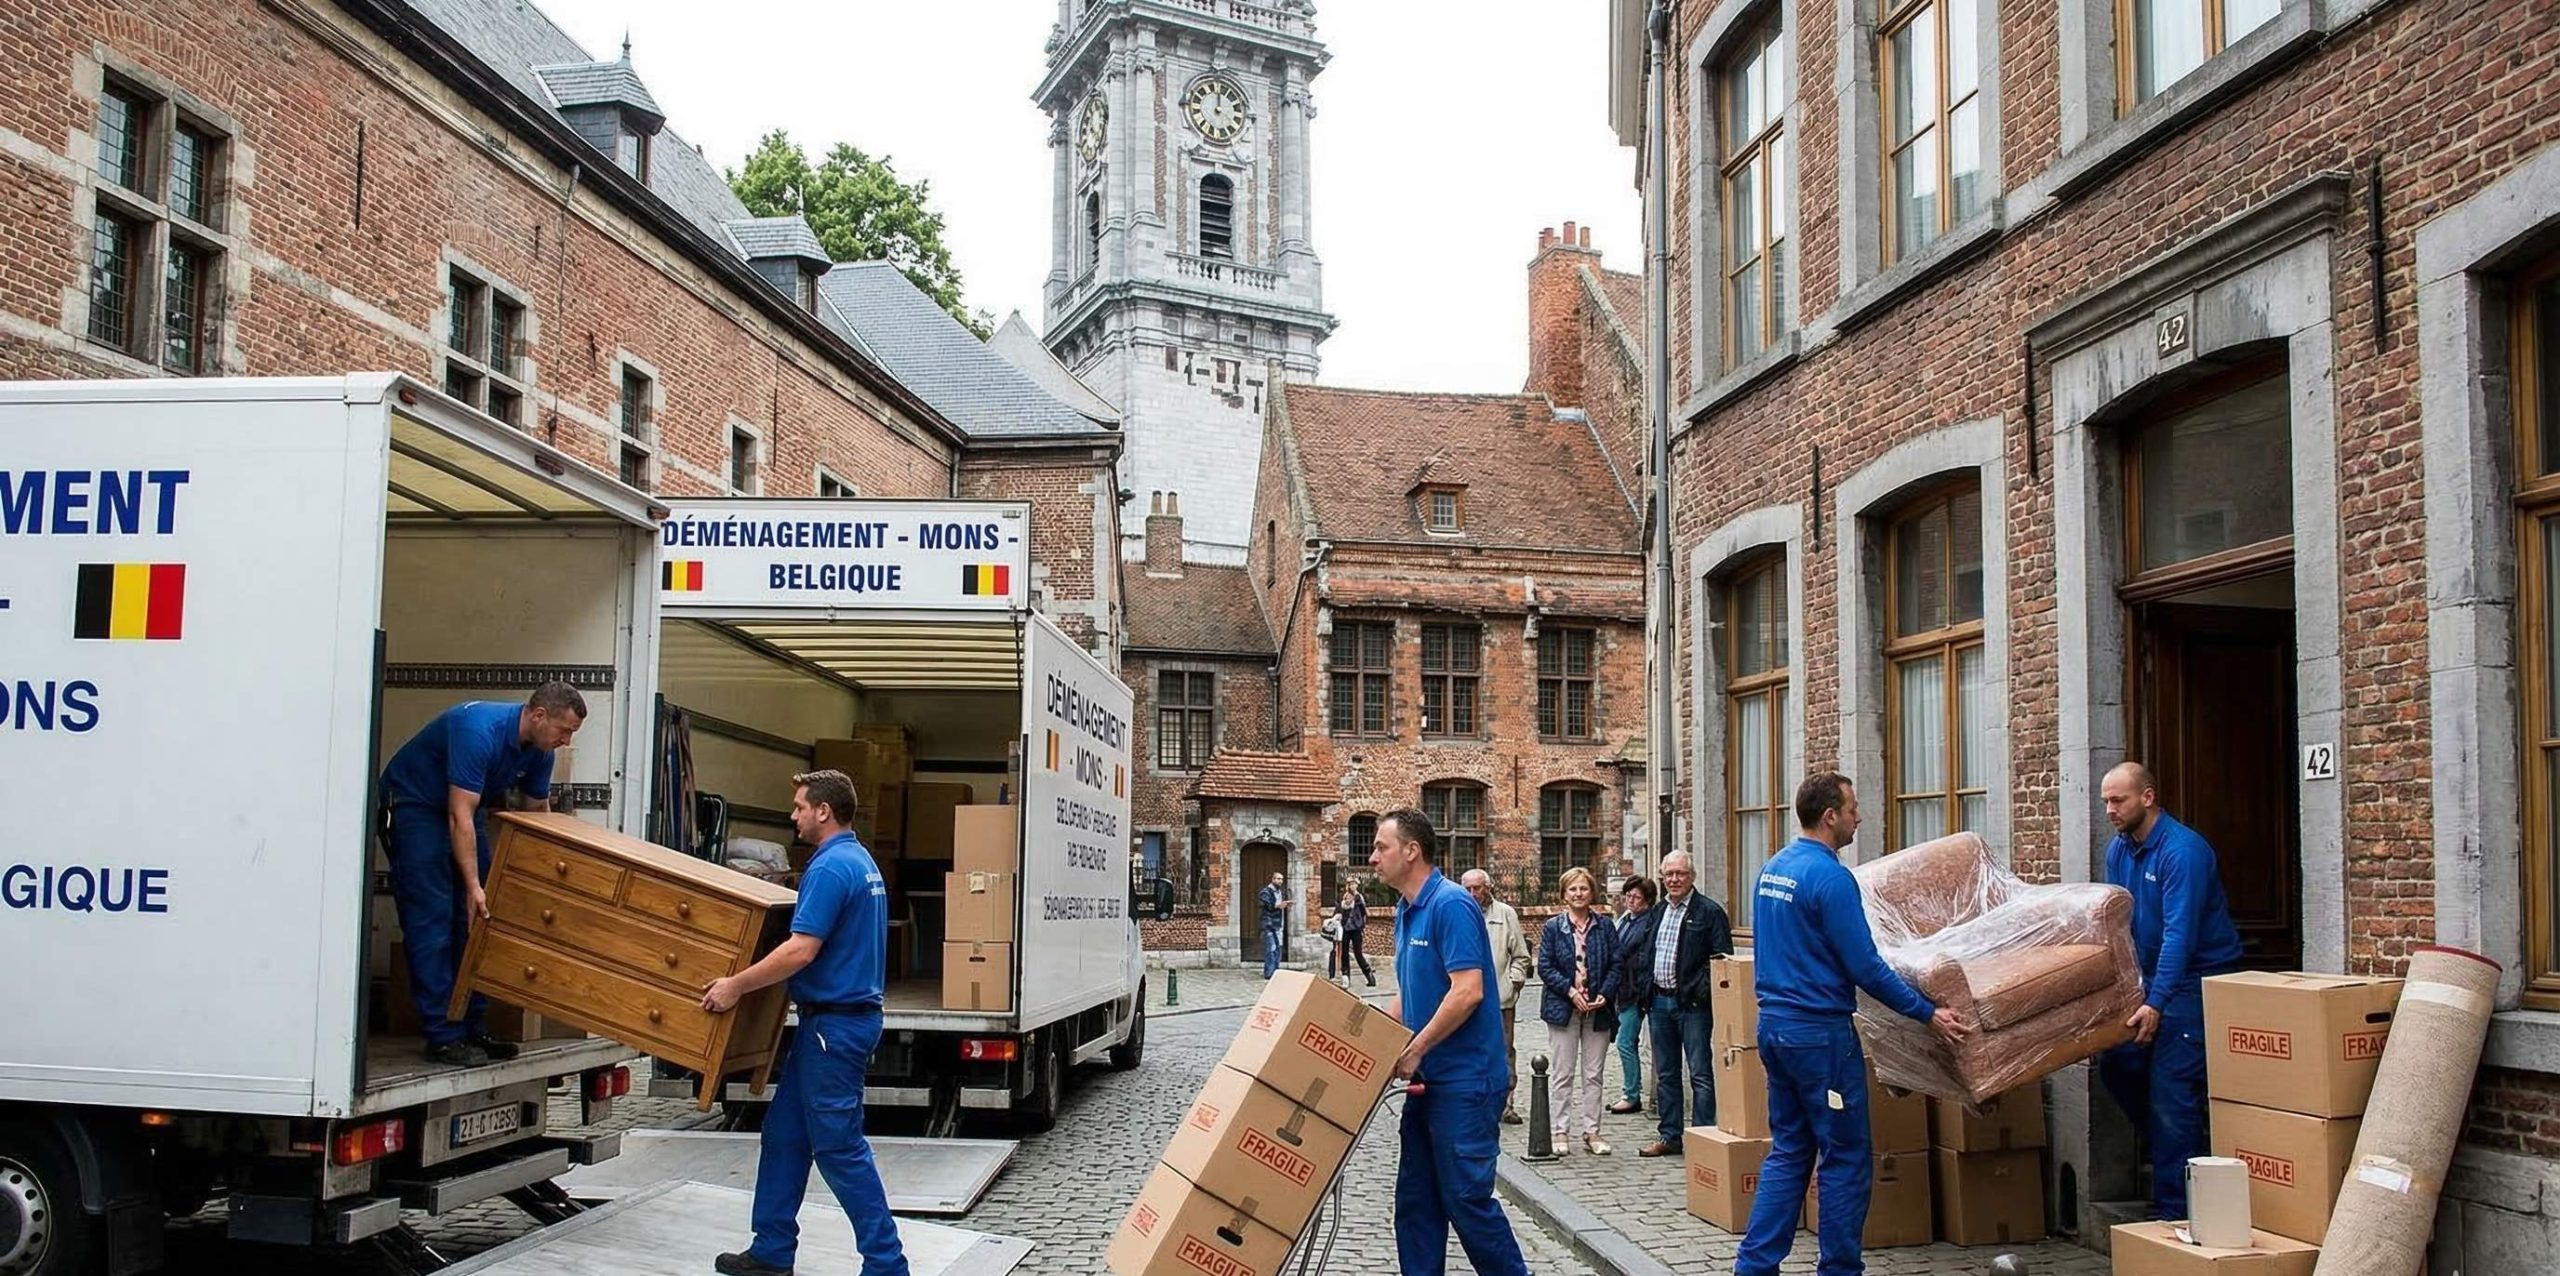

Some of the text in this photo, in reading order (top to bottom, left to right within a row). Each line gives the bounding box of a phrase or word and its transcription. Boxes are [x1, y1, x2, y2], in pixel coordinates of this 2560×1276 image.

[2158, 315, 2185, 351] 42
[0, 471, 190, 534] MENT
[662, 514, 888, 548] DÉMÉNAGEMENT
[919, 523, 999, 550] MONS
[769, 563, 901, 593] BELGIQUE
[0, 680, 100, 732] NS
[1047, 669, 1126, 753] DÉMÉNAGEMENT
[1076, 745, 1103, 790] MONS
[2307, 747, 2330, 775] 42
[2, 864, 169, 914] GIQUE
[1304, 1028, 1370, 1077] FRAGILE
[2232, 1032, 2288, 1054] FRAGILE
[1243, 1134, 1310, 1182] FRAGILE
